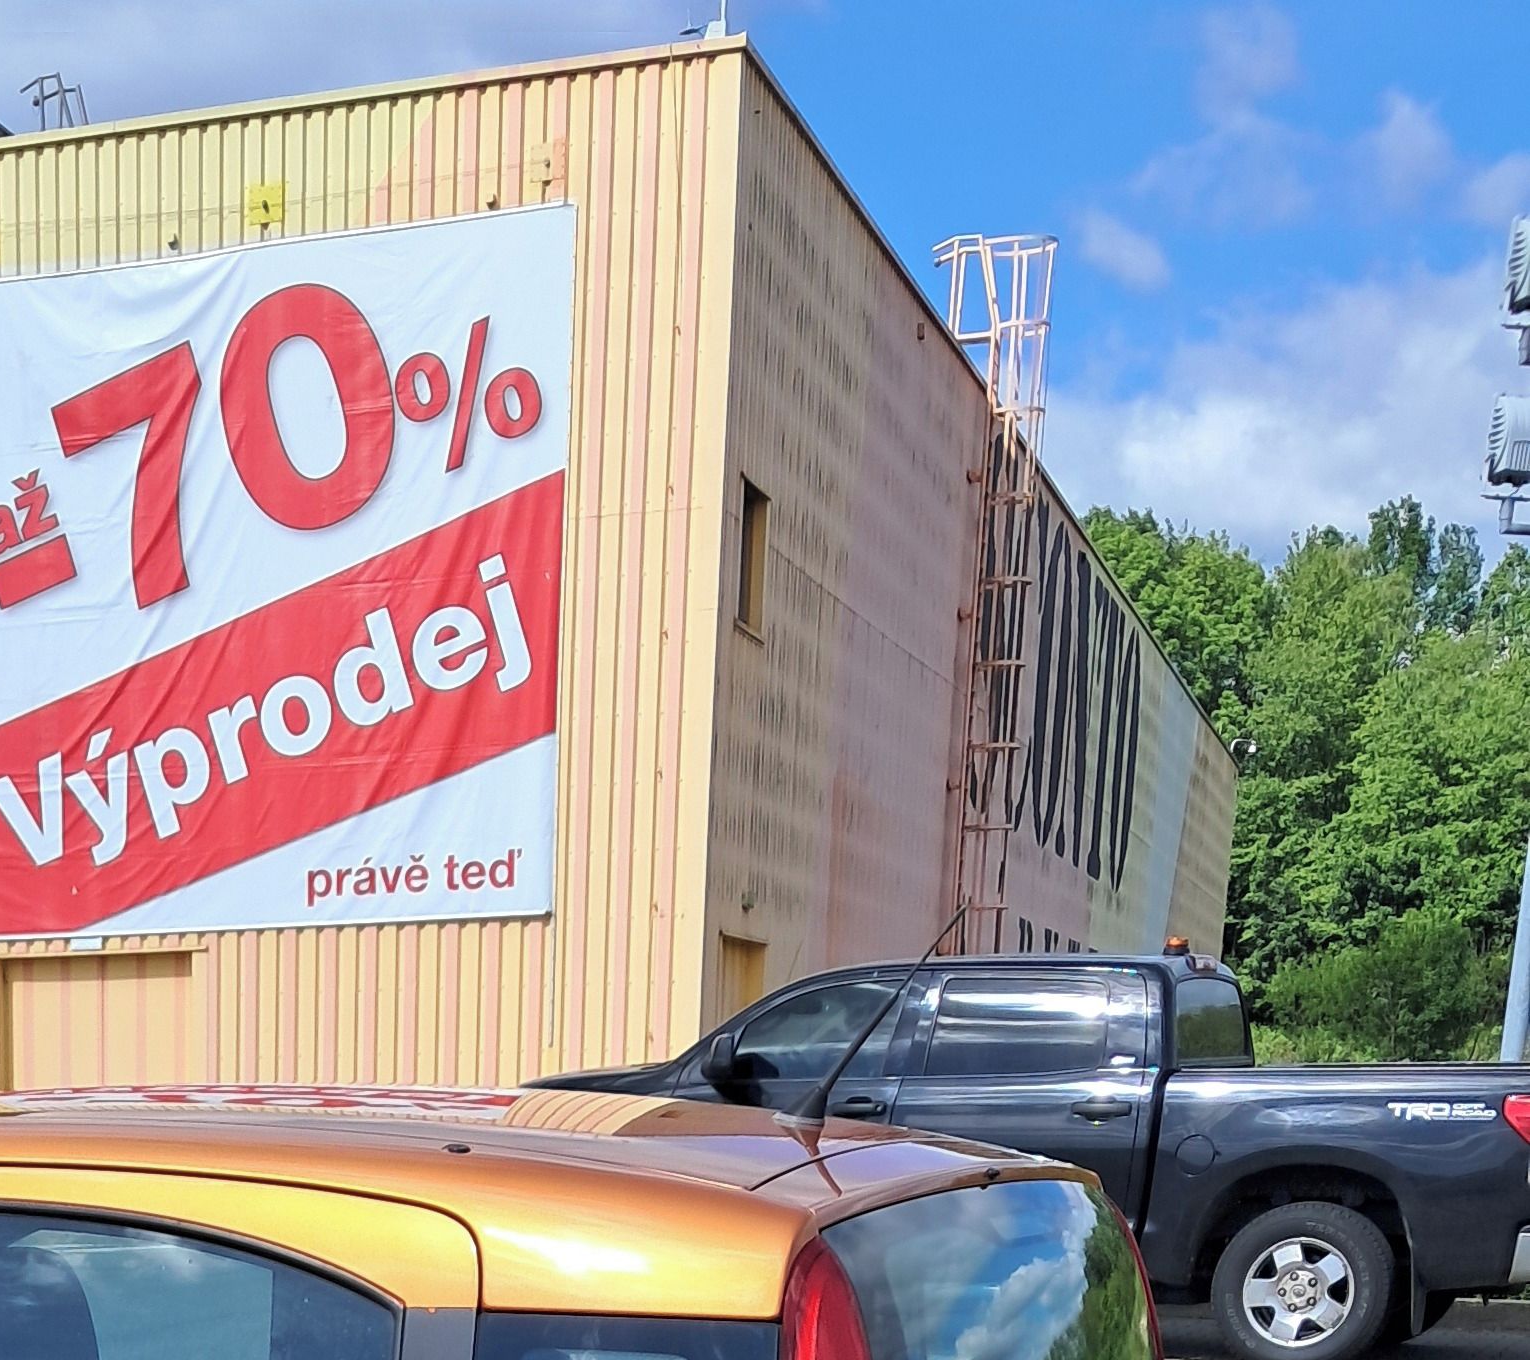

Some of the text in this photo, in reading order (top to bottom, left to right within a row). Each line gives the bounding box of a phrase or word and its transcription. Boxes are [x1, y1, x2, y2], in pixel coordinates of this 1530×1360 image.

[306, 848, 523, 906] právě teď
[1387, 1102, 1451, 1121] TRD
